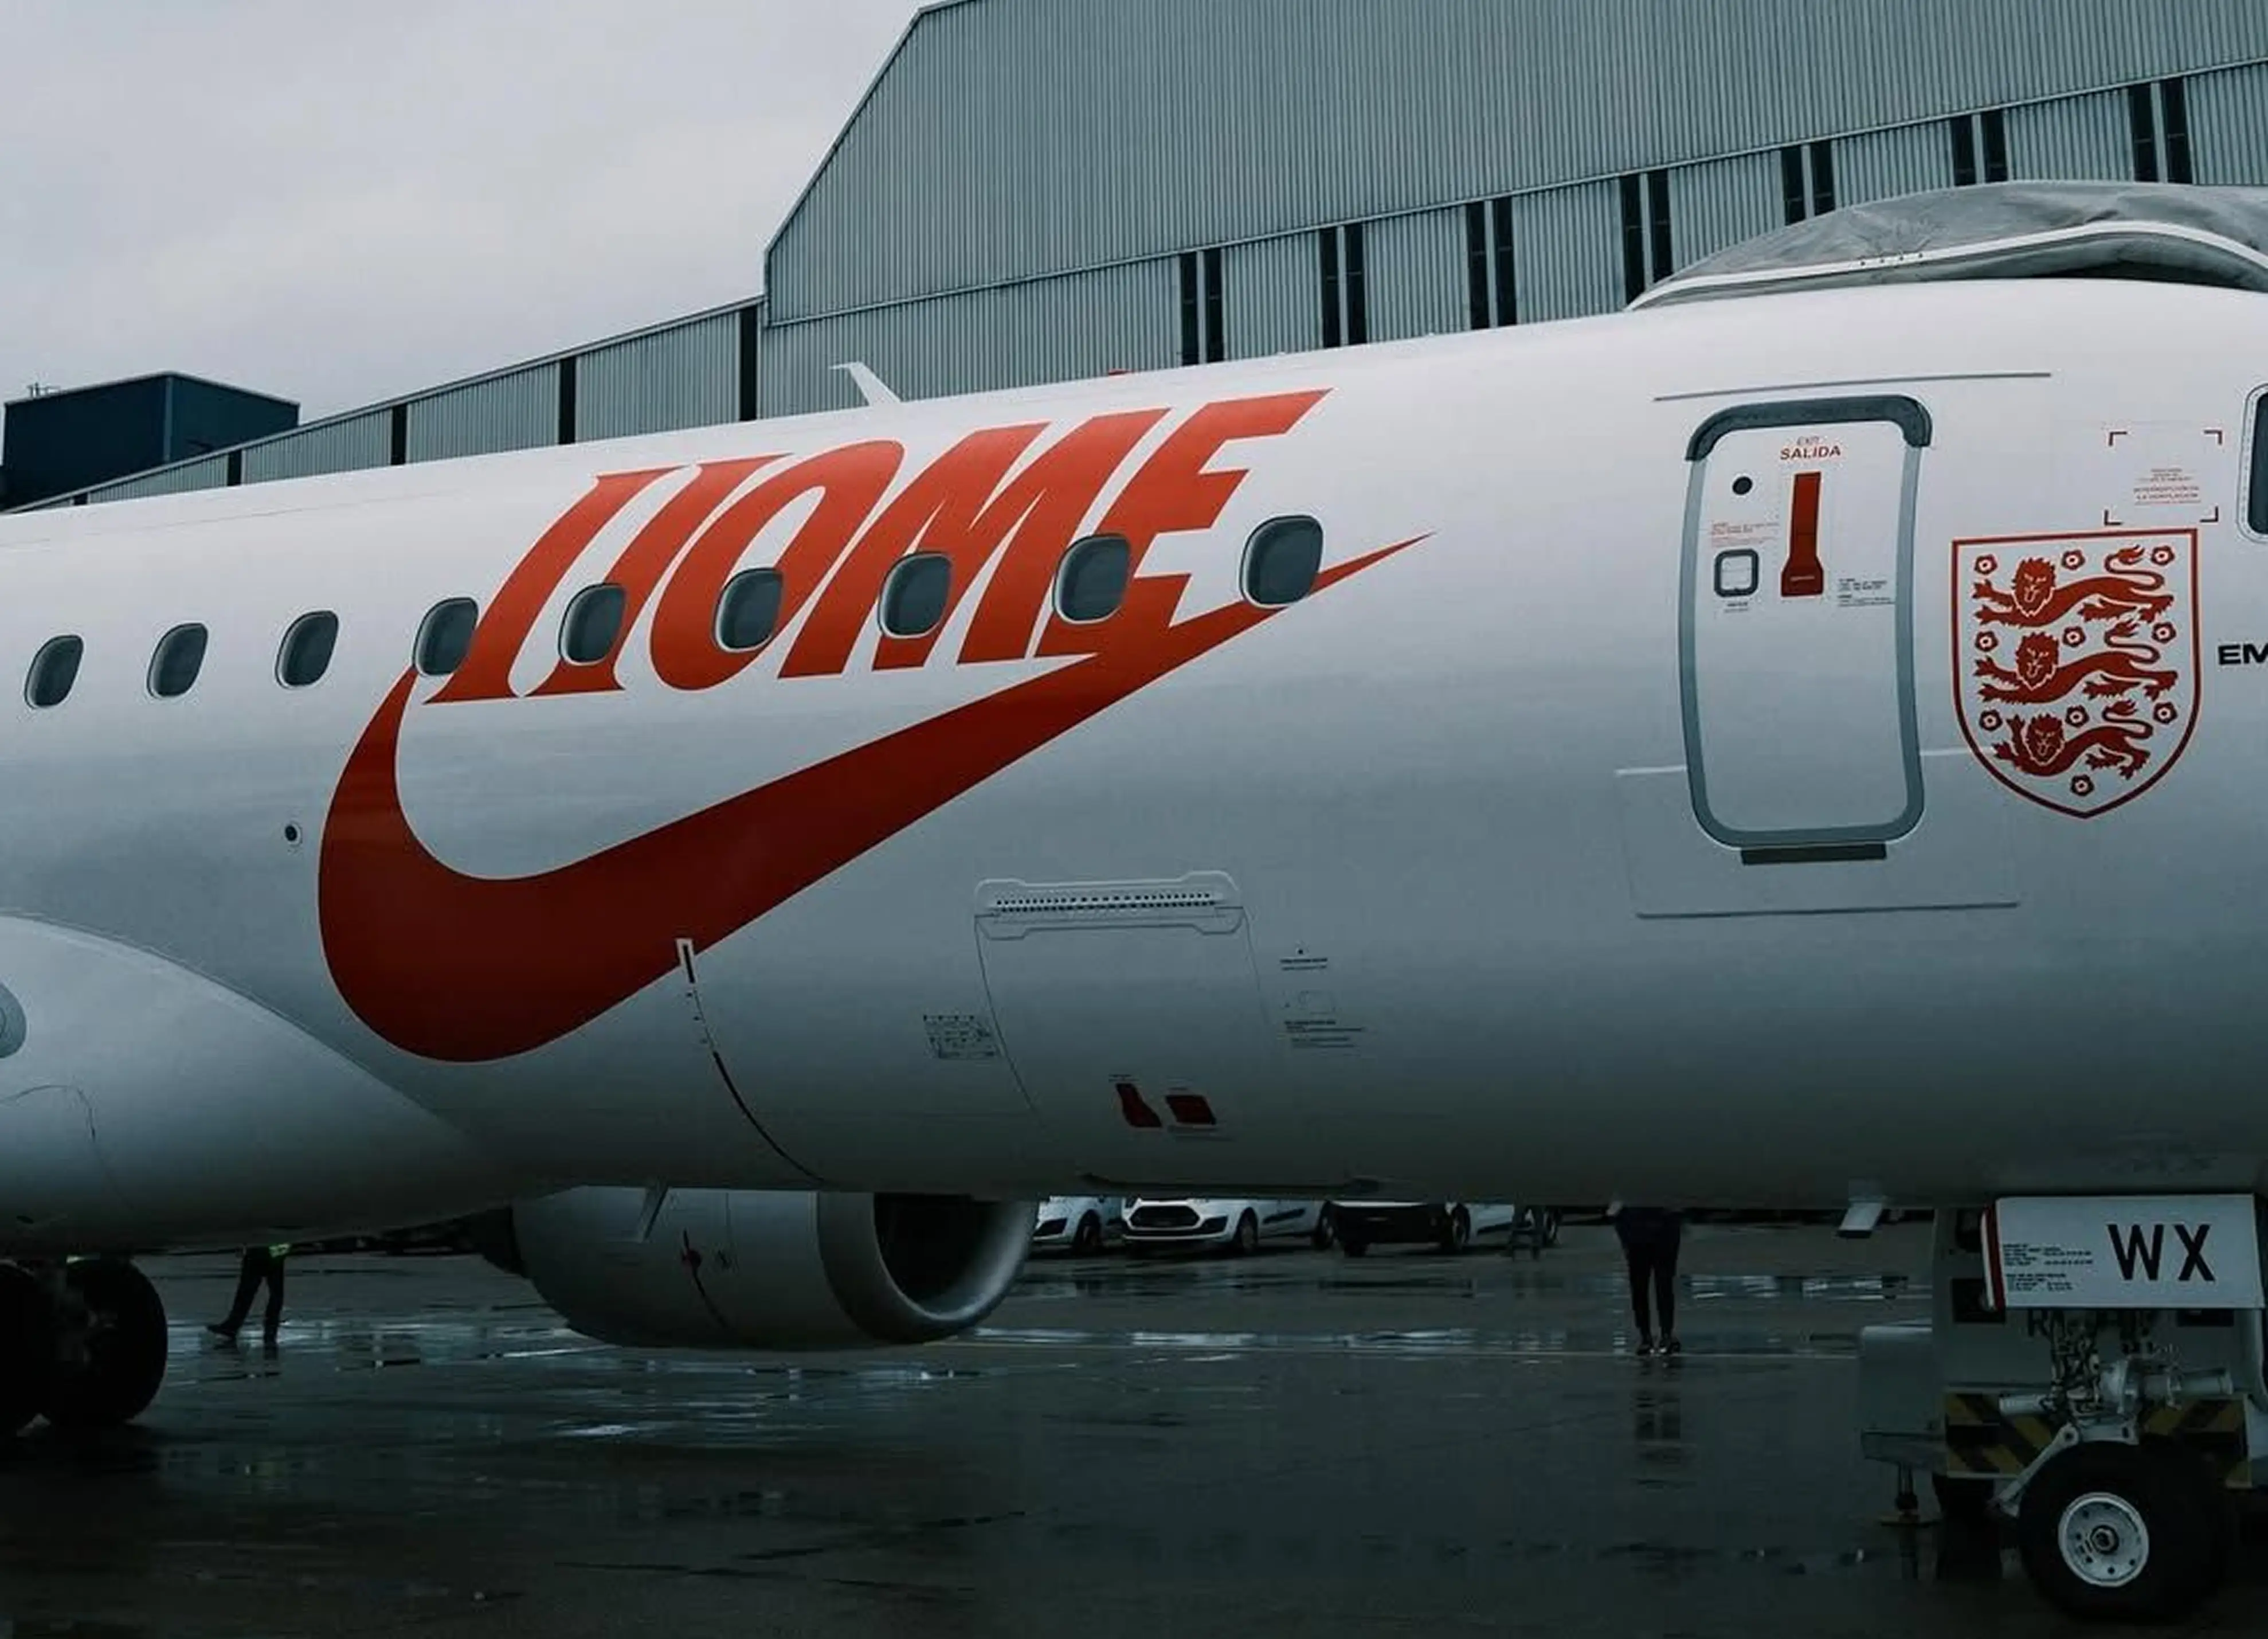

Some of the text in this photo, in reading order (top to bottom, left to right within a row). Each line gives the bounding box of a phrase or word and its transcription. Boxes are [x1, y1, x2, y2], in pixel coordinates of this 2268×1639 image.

[1780, 445, 1842, 460] SALIDA
[2218, 643, 2268, 666] EM
[2107, 1224, 2216, 1281] WX
